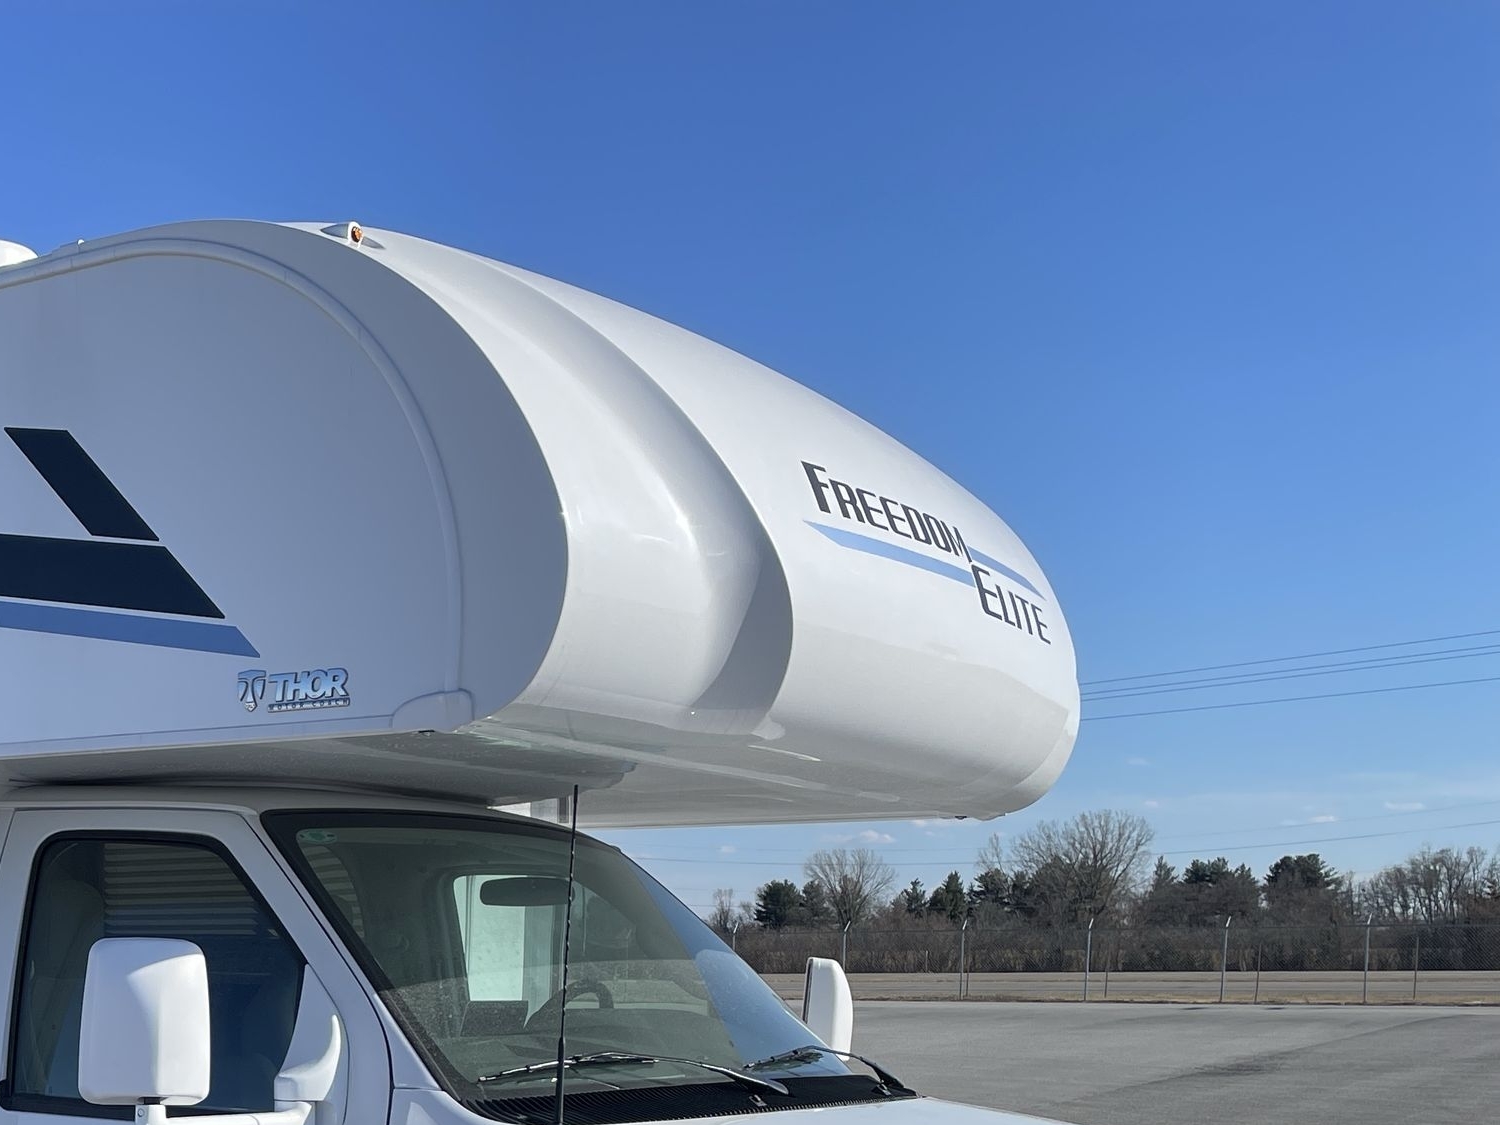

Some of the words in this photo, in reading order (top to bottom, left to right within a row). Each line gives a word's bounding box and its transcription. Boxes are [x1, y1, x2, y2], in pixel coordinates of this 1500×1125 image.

[800, 460, 973, 564] FREEDOM
[971, 564, 1052, 645] ELITE
[268, 667, 350, 702] THOR
